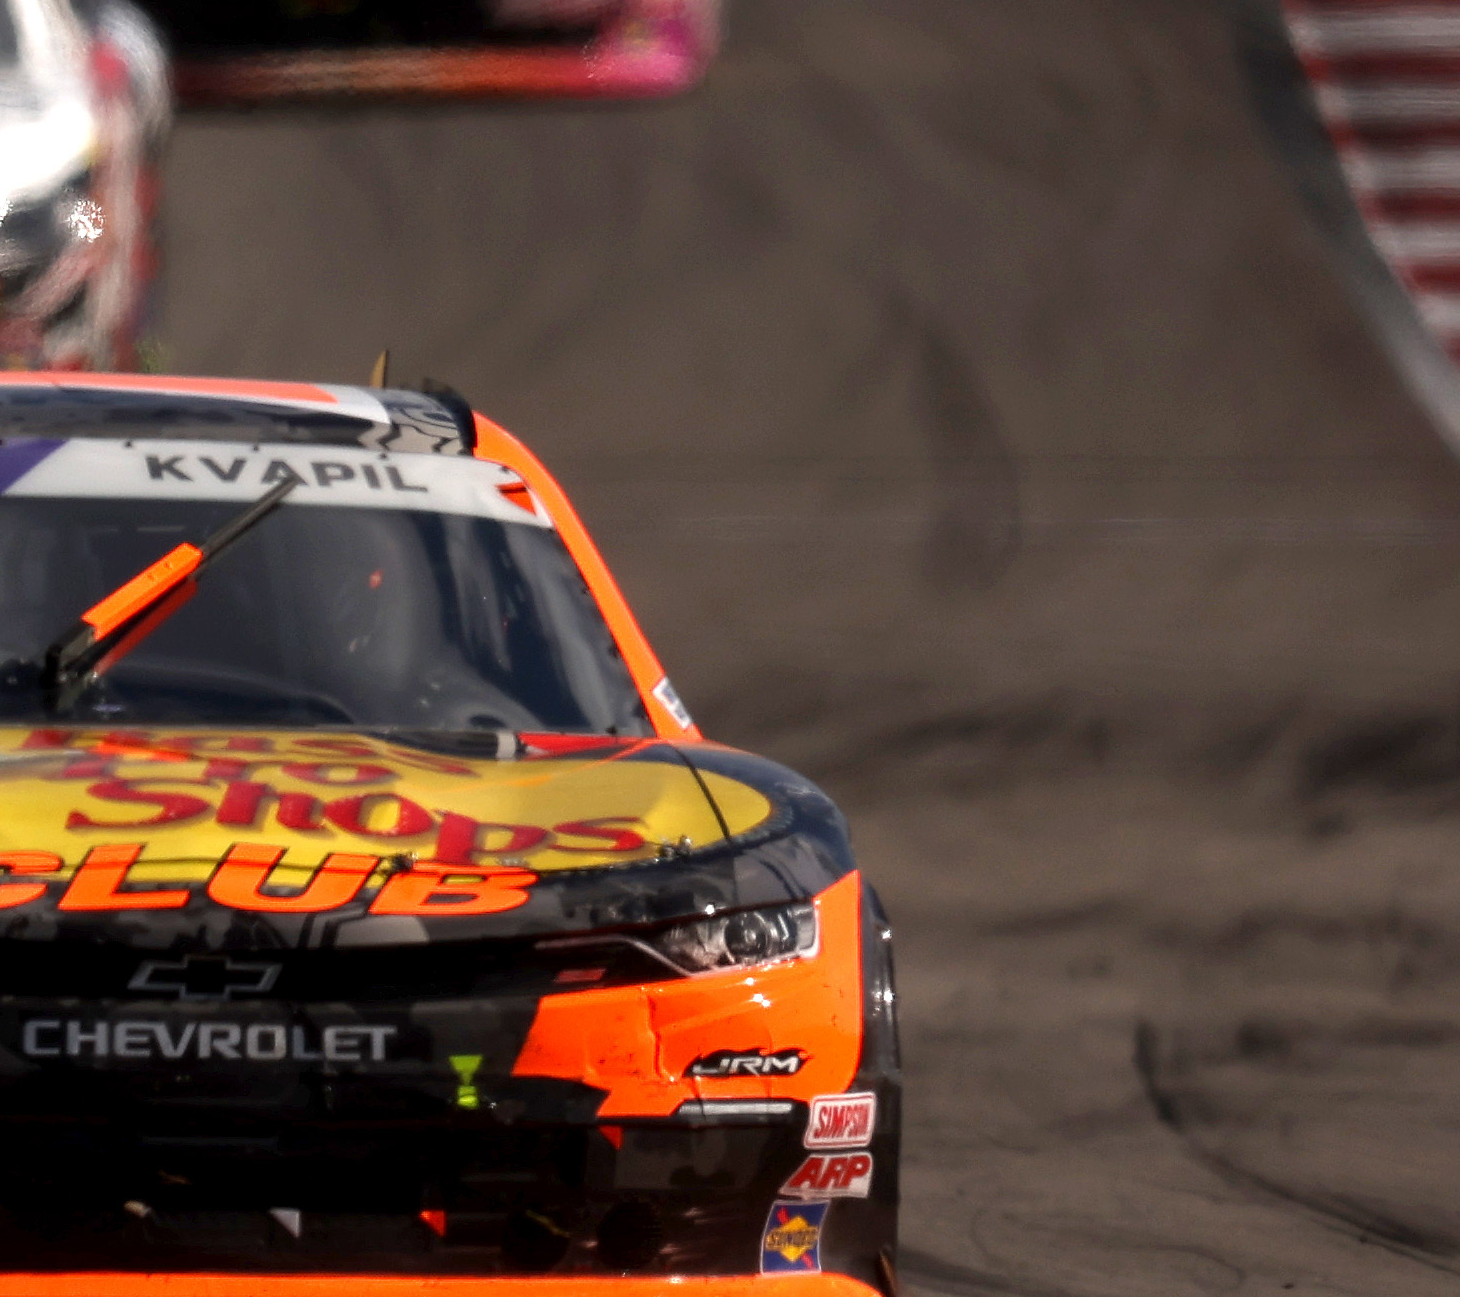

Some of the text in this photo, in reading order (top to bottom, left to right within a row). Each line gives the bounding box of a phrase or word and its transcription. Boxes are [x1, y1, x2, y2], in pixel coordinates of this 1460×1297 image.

[146, 452, 430, 494] KVAPIL
[66, 775, 651, 867] Shops
[22, 1018, 397, 1062] CHEVROLET
[691, 1054, 801, 1076] JRM
[815, 1103, 871, 1140] SIMPSON
[788, 1154, 871, 1190] ARP
